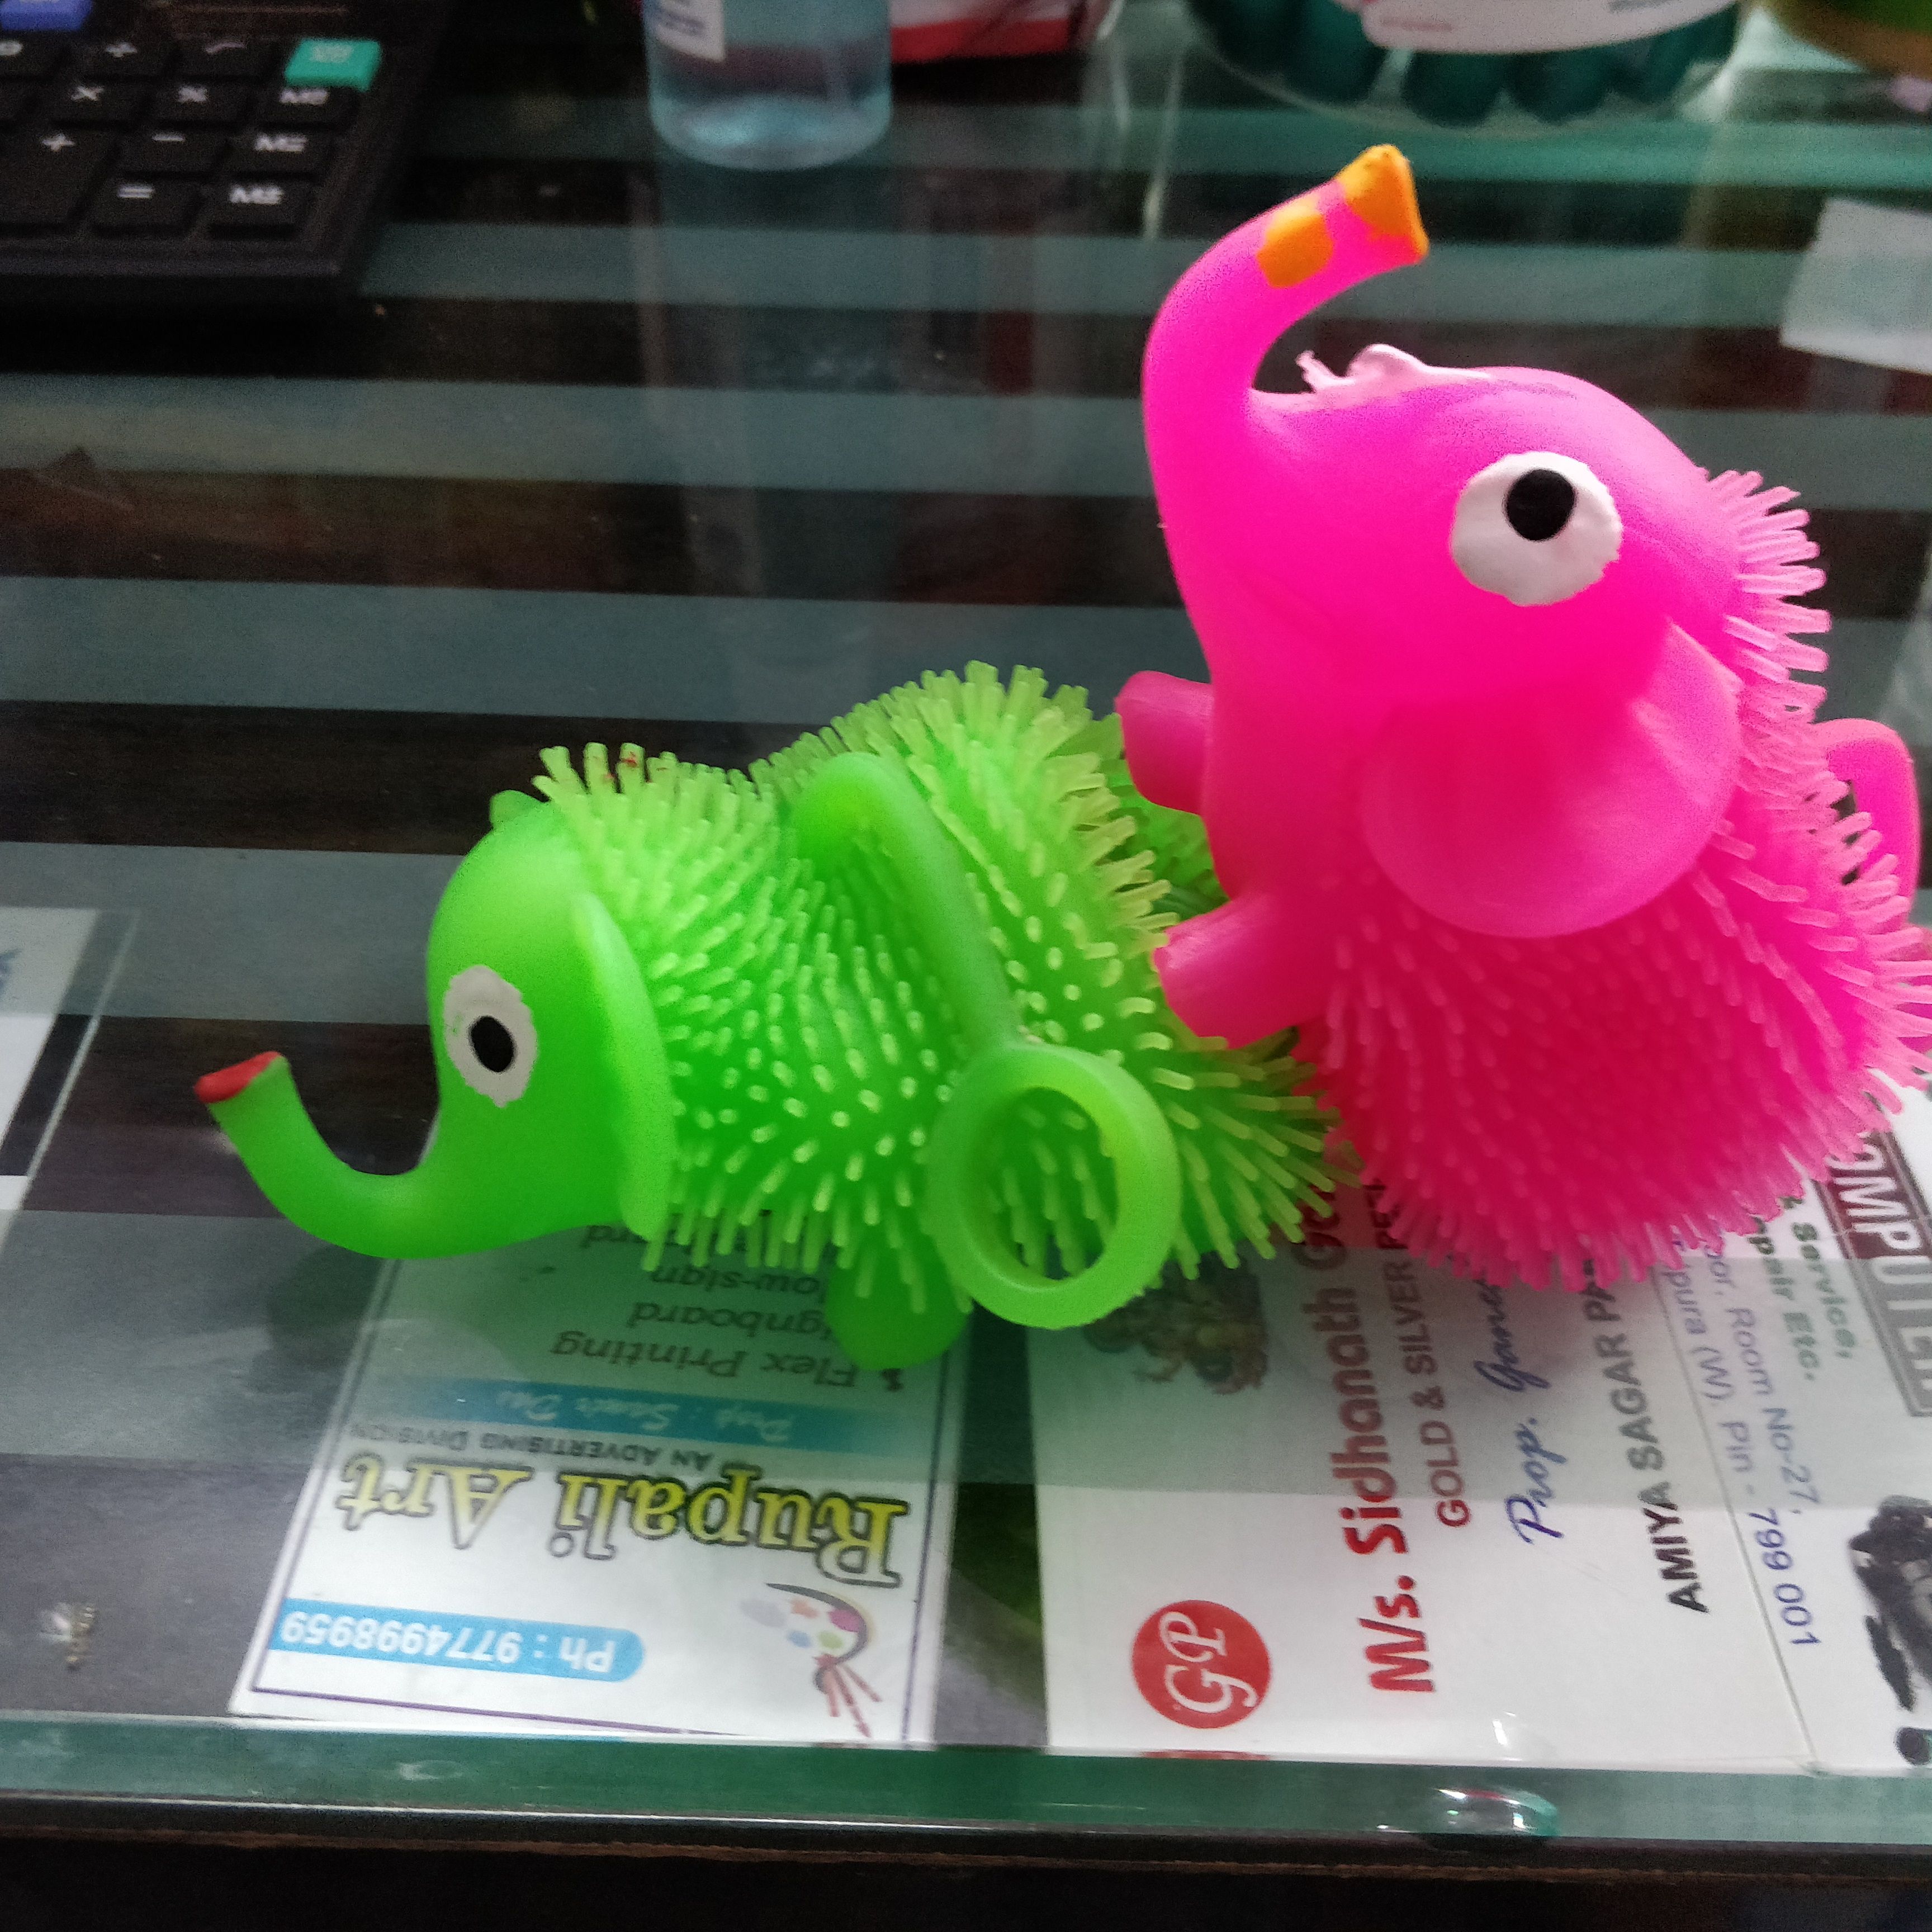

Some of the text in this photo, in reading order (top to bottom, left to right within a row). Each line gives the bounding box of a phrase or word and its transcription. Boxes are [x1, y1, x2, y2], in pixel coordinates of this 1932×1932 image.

[549, 1329, 862, 1389] Flex Printing
[1382, 1260, 1439, 1376] SILVER
[1725, 1306, 1777, 1396] Room
[480, 1431, 660, 1466] ADVERTISING
[1301, 1287, 1409, 1555] Sidhanath
[1409, 1385, 1446, 1411] &
[1594, 1332, 1666, 1472] SAGAR
[670, 1448, 716, 1472] AN
[1419, 1420, 1472, 1528] GOLD
[1504, 1417, 1569, 1545] Prop.
[333, 1451, 912, 1589] Rupali Art
[1637, 1480, 1711, 1614] AMIYA
[1716, 1419, 1756, 1474] Pin
[1747, 1506, 1796, 1572] 799
[1772, 1581, 1823, 1645] 001
[281, 1610, 524, 1664] 9774998959
[559, 1635, 617, 1674] Ph
[1356, 1574, 1437, 1693] M/s.
